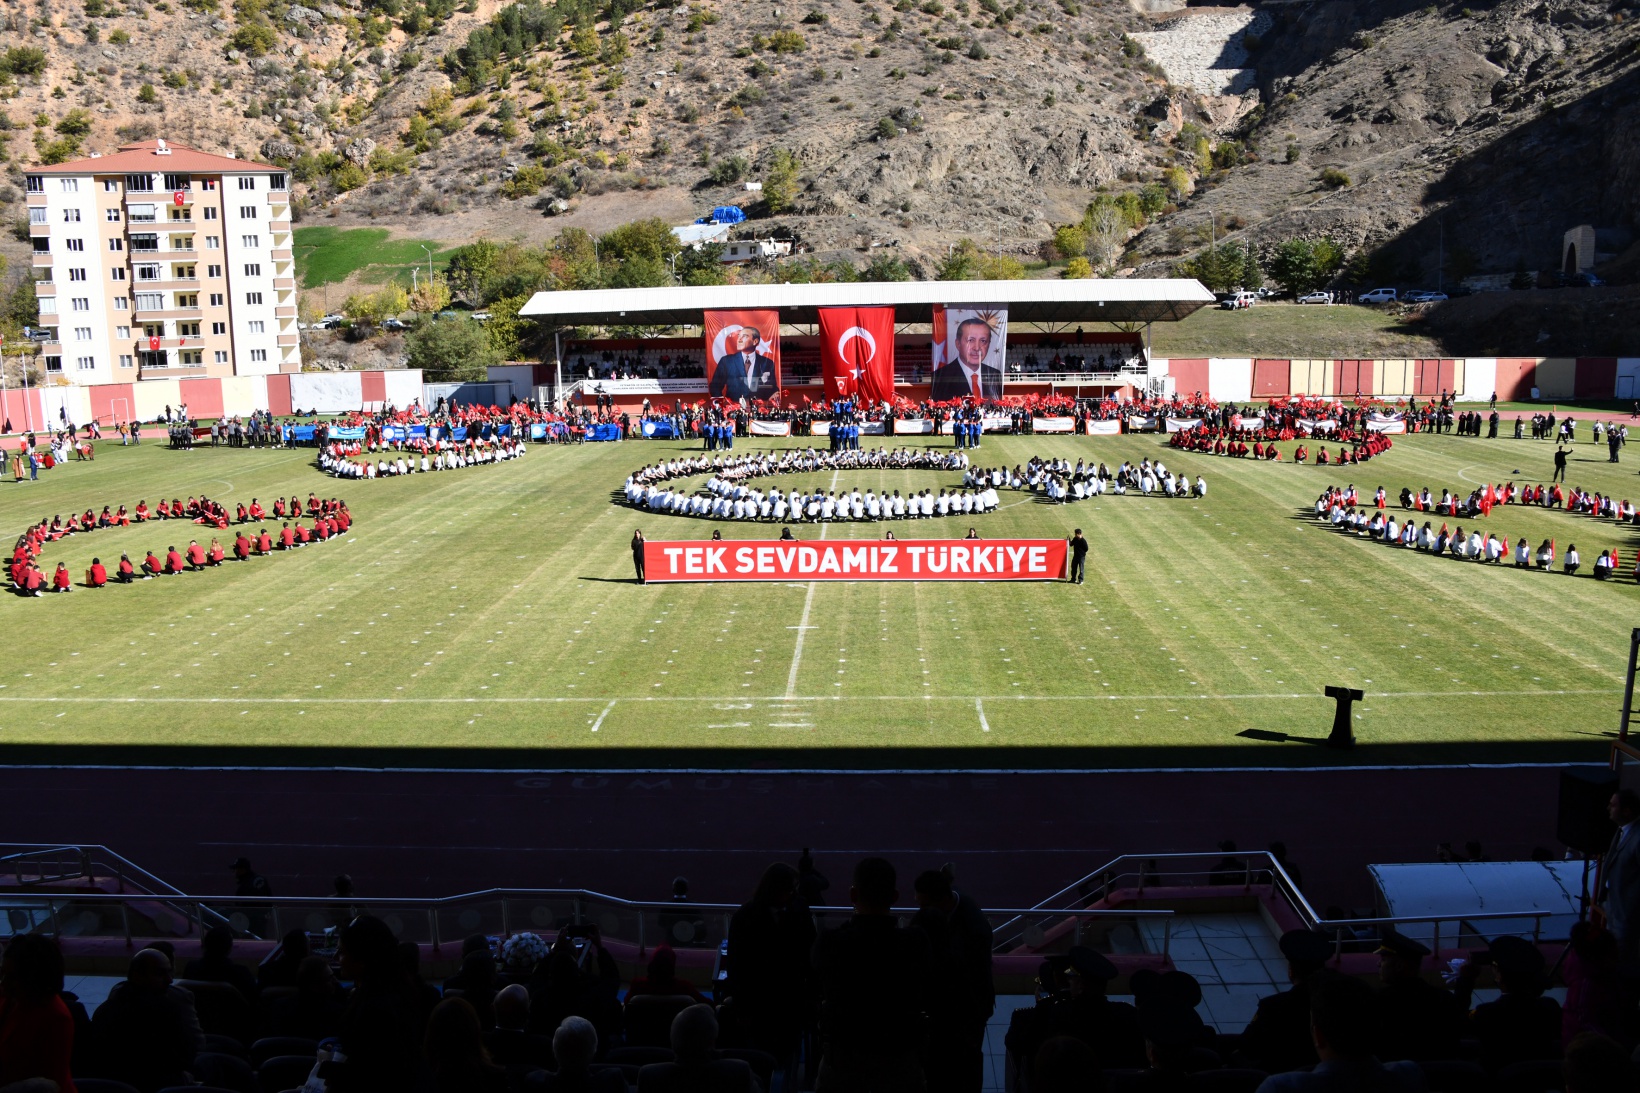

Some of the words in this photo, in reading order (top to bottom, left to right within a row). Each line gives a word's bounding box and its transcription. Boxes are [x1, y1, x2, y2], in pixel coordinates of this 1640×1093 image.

[663, 546, 728, 573] TEK
[735, 545, 899, 573] SEVDAMIZ
[906, 545, 1047, 573] TÜRKİYE
[513, 776, 998, 793] GÜMÜŞHANE
